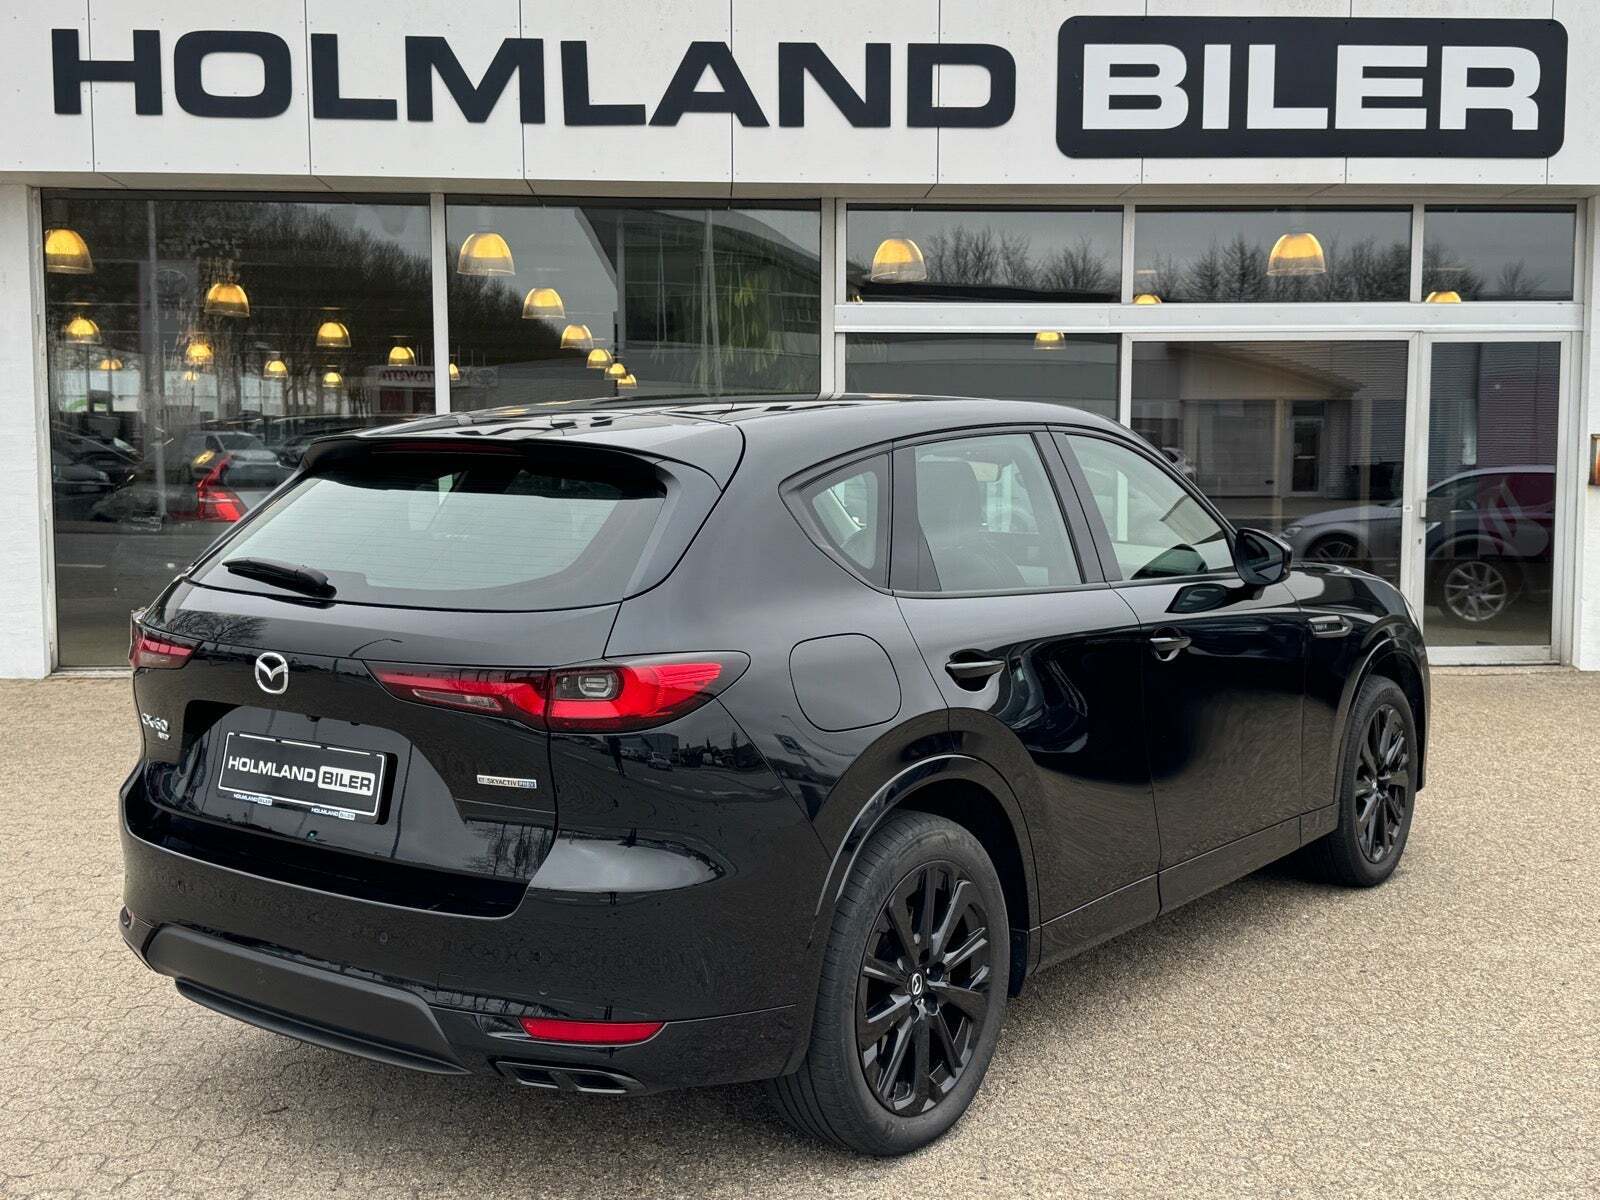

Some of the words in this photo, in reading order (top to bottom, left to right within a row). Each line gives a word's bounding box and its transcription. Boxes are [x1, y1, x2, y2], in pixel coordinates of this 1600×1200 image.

[51, 28, 1017, 128] HOLMLAND
[1081, 43, 1541, 131] BILER
[227, 755, 316, 783] HOLMLAND
[321, 770, 372, 792] BILER
[233, 793, 258, 802] HOLMLAND
[311, 807, 339, 816] HOLMLAND
